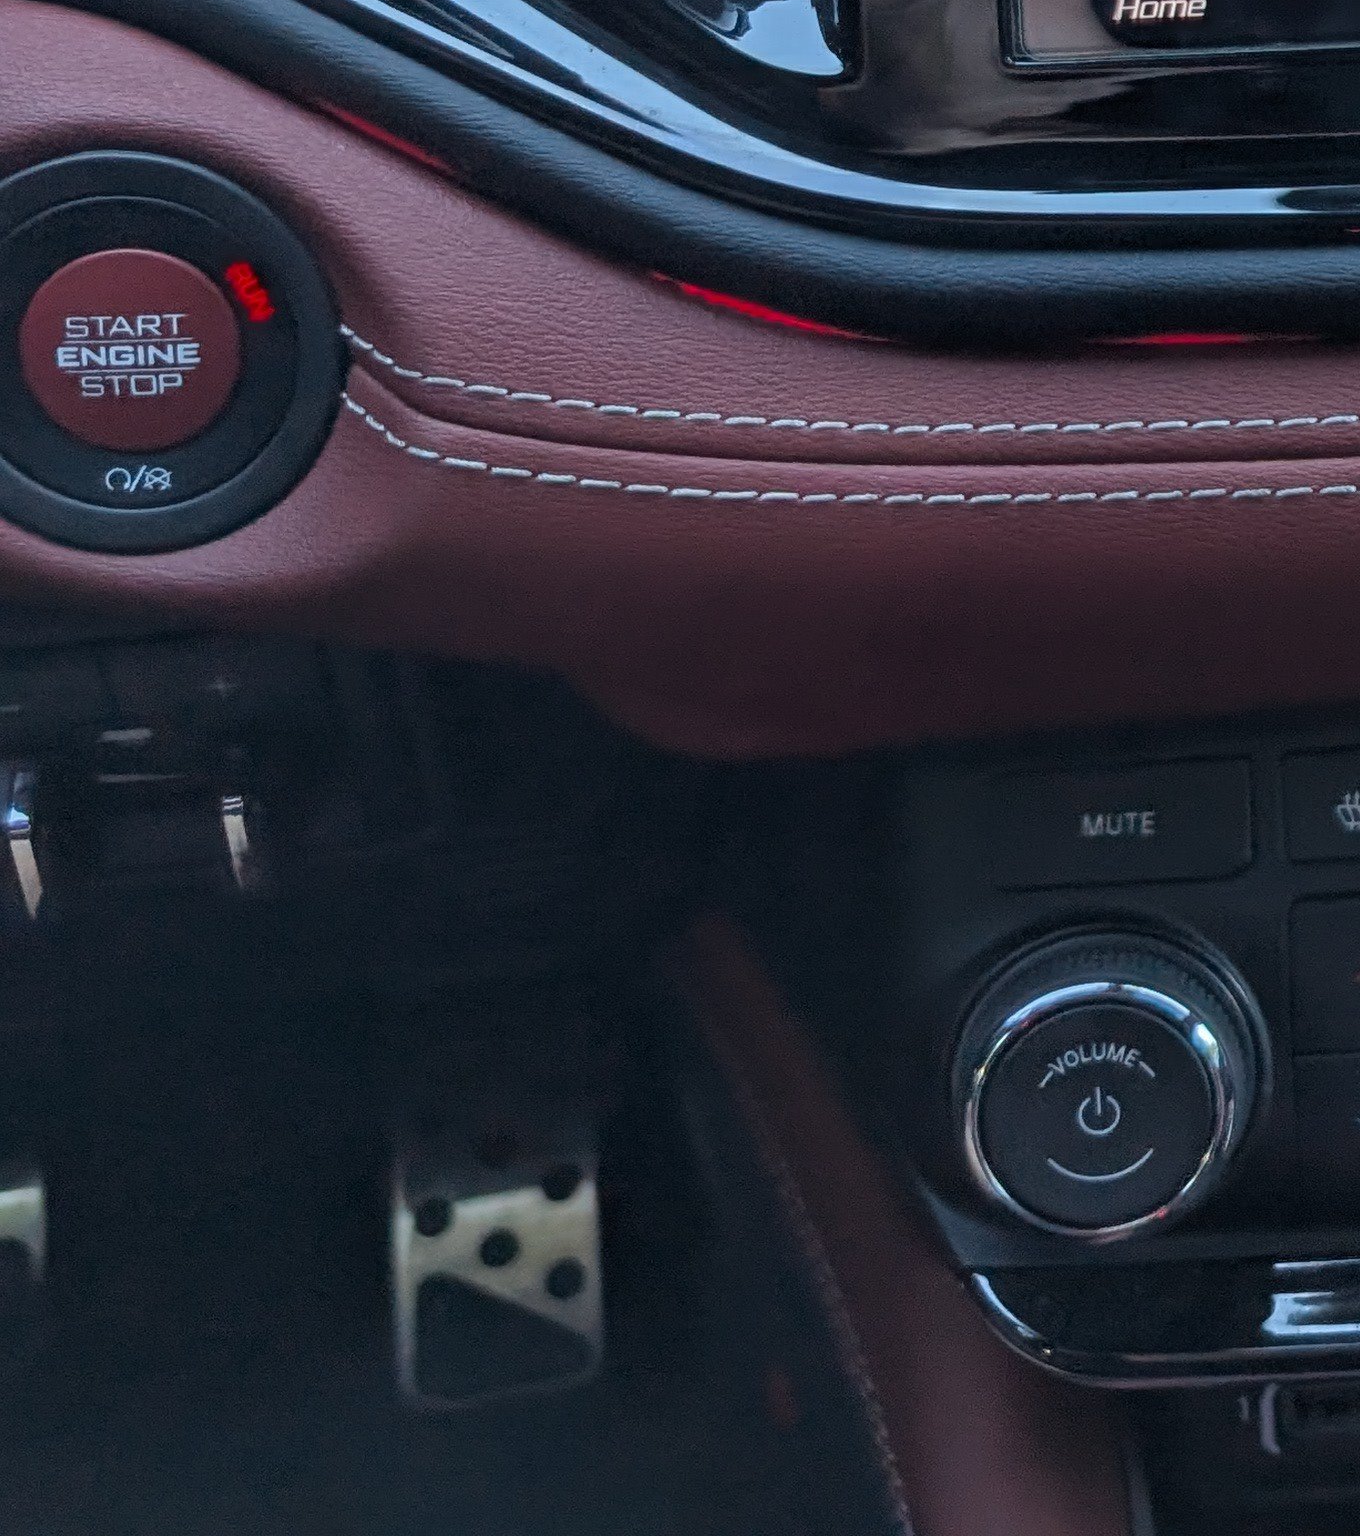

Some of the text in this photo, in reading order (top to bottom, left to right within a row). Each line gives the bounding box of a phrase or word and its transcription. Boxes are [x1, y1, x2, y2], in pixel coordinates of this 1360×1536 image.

[65, 313, 188, 338] START
[56, 342, 201, 368] ENGINE
[81, 373, 183, 398] STOP
[1080, 811, 1156, 838] MUTE
[1048, 1042, 1141, 1076] VOLUME
